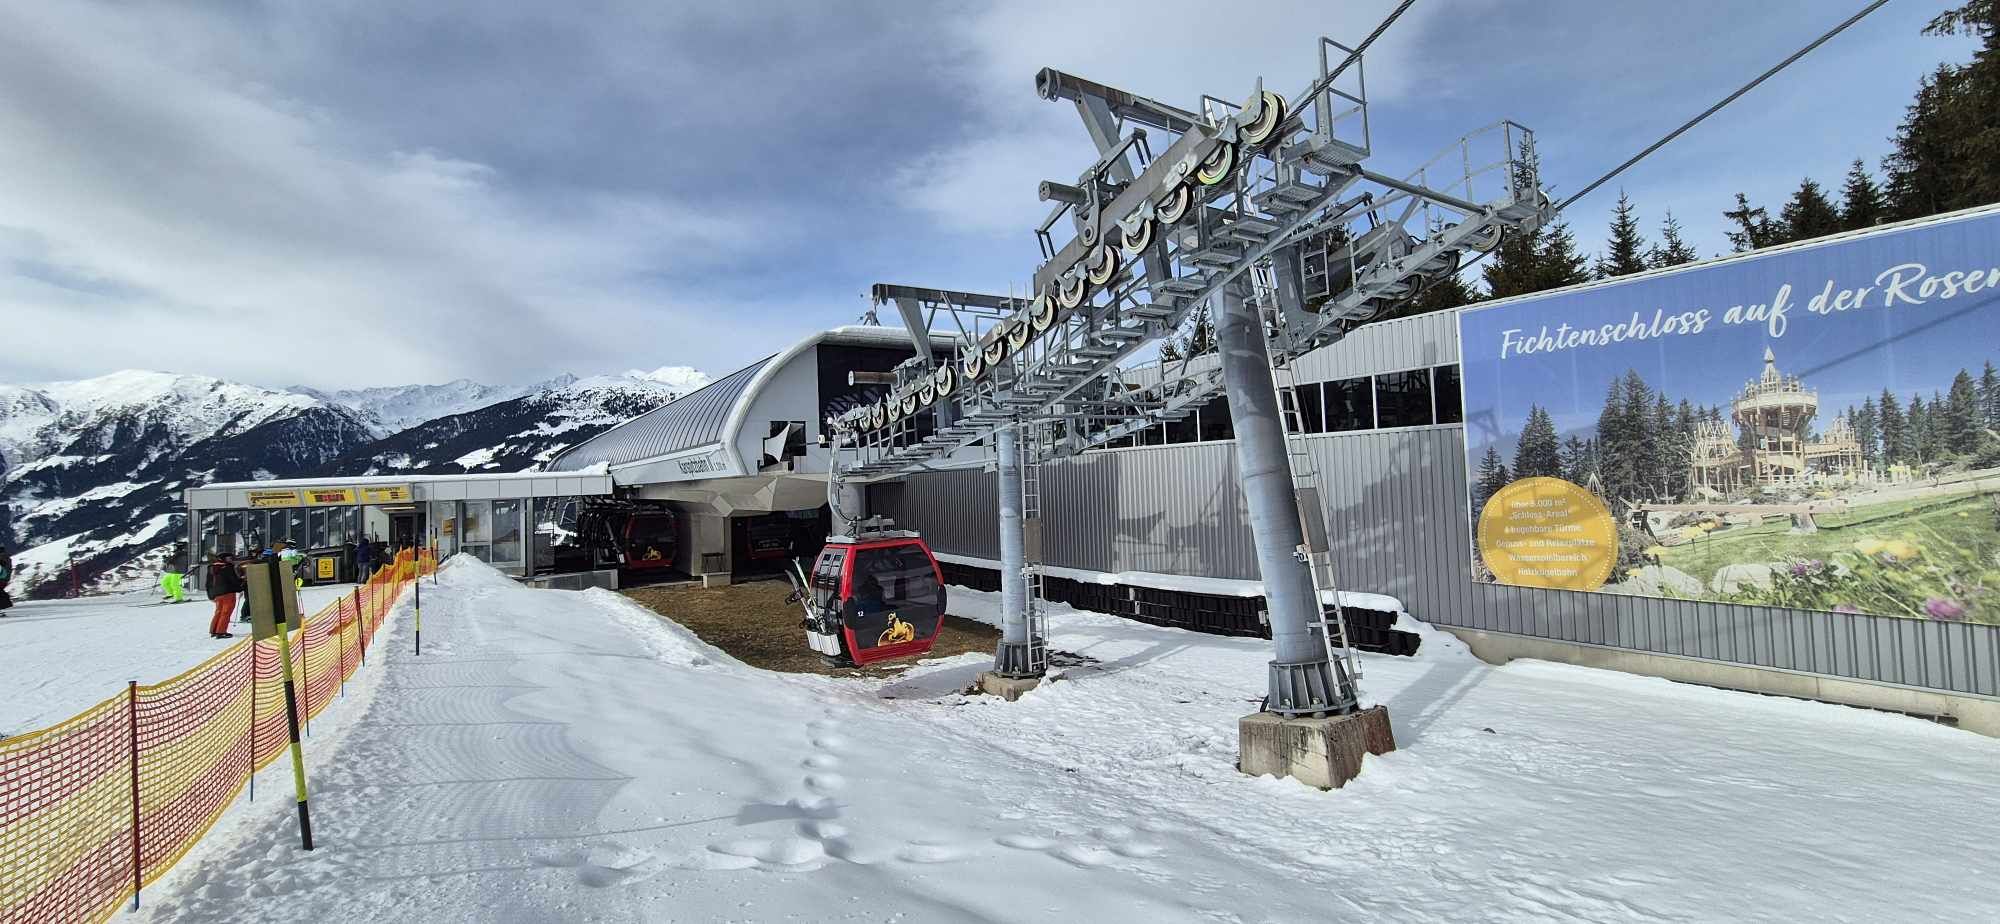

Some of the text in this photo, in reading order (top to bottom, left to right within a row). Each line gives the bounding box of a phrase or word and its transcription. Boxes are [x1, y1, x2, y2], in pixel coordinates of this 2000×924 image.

[1500, 307, 1712, 360] Fichtenschloss
[1723, 283, 1794, 338] auf
[1807, 279, 1874, 315] der
